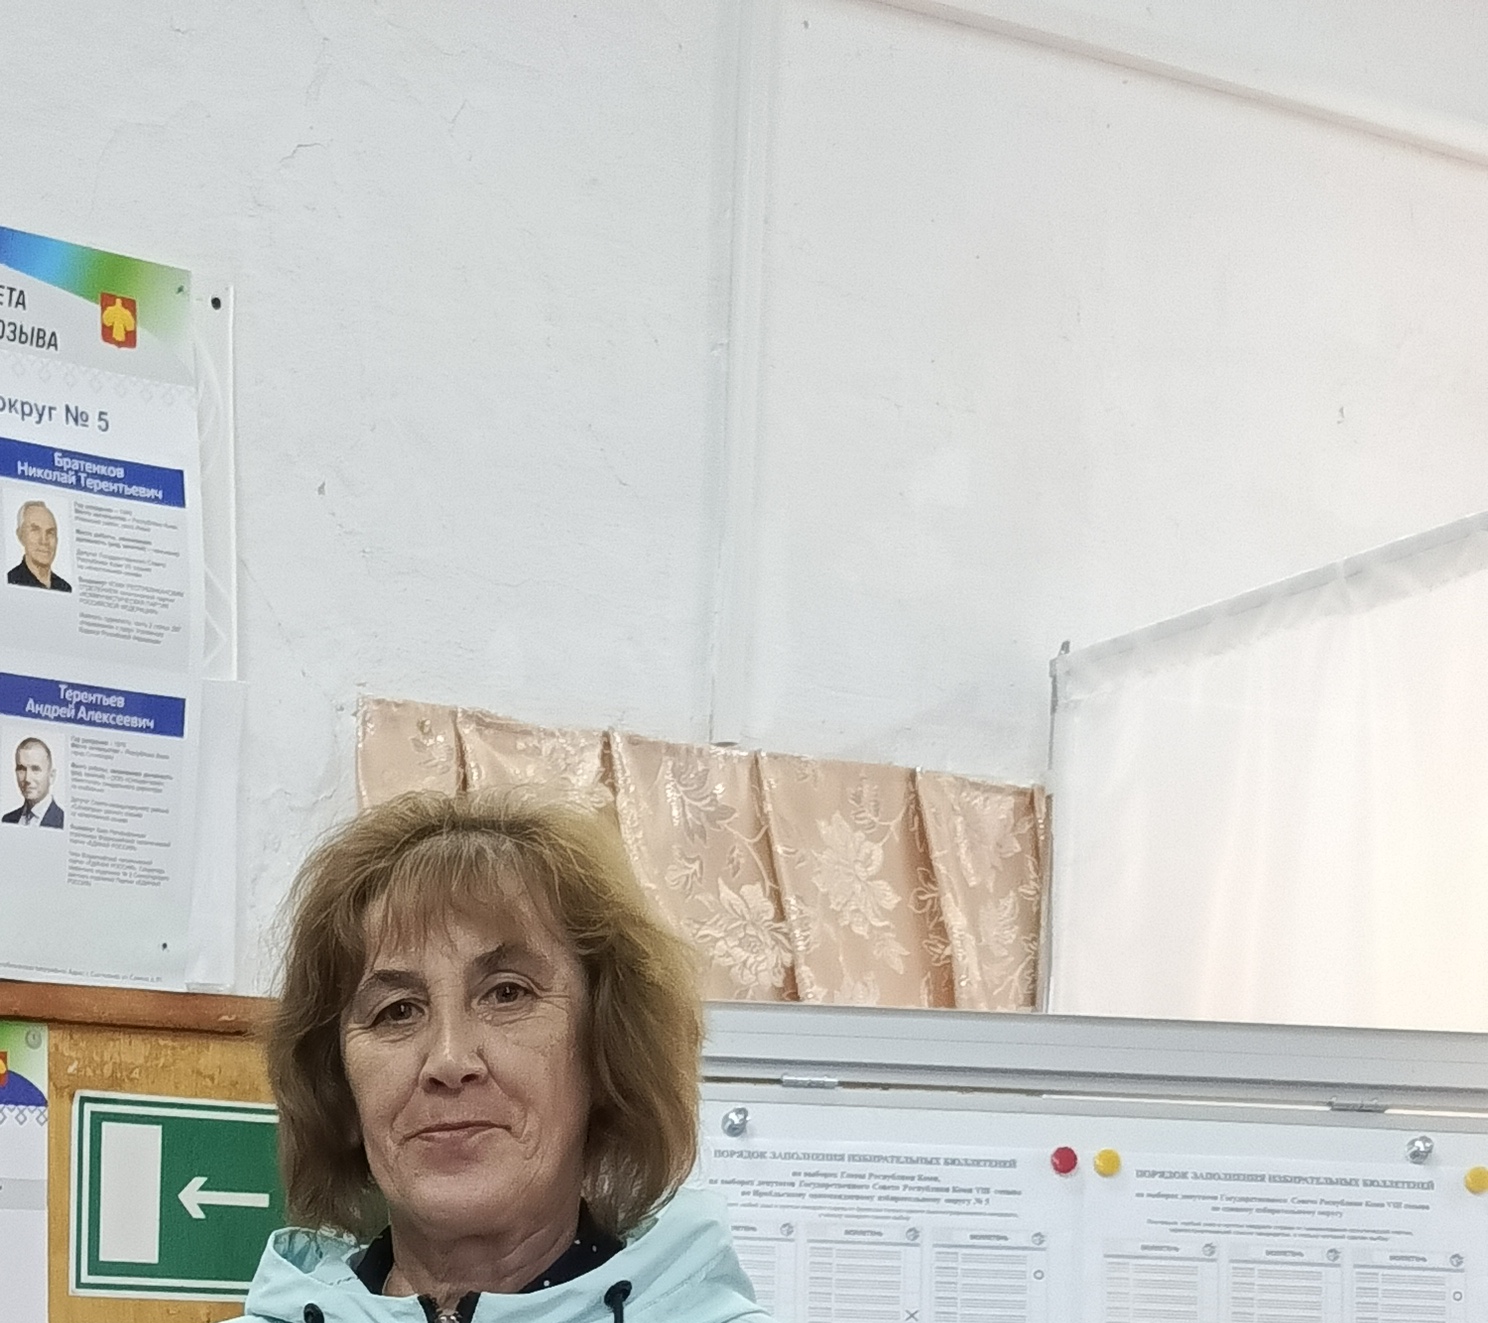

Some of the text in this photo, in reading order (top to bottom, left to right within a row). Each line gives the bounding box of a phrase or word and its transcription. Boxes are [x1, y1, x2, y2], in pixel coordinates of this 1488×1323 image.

[64, 403, 89, 428] №
[97, 411, 110, 433] 5
[17, 460, 163, 500] Николай Терентьевич
[53, 452, 125, 479] Братенков
[58, 684, 125, 708] Терентьев
[25, 697, 155, 729] Андрей Алексеевич
